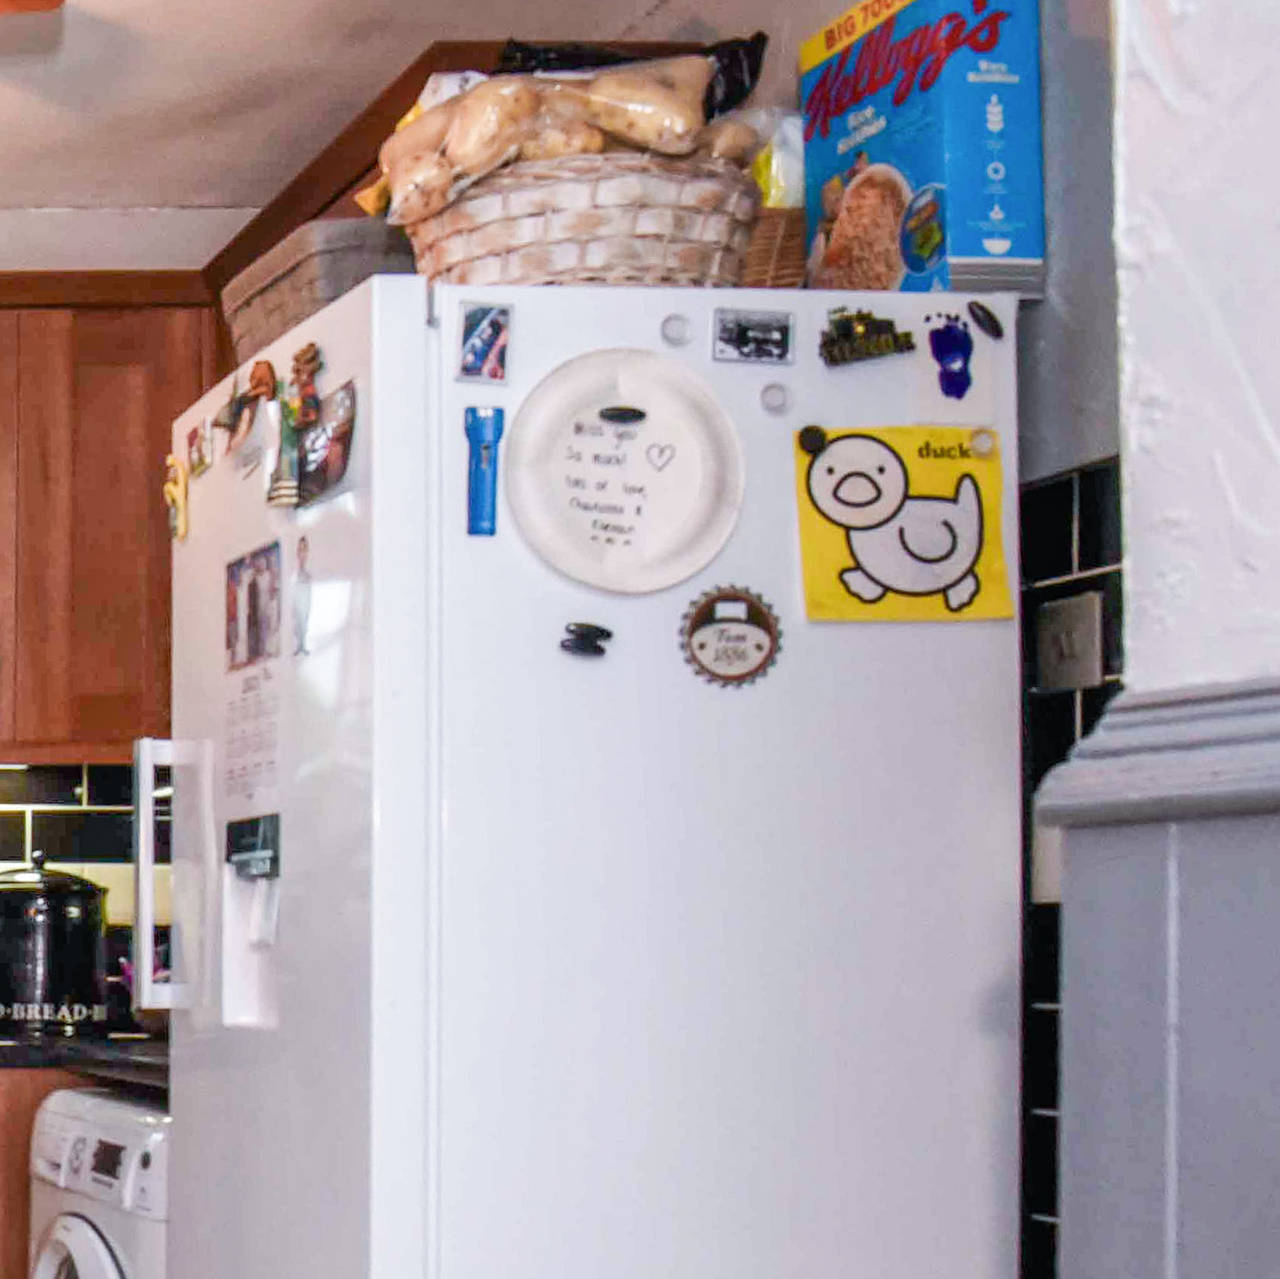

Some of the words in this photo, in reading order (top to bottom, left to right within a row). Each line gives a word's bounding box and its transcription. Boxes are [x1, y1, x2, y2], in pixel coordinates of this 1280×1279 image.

[824, 15, 856, 50] BIG
[803, 0, 1010, 142] Kellogg's
[917, 441, 972, 459] duck
